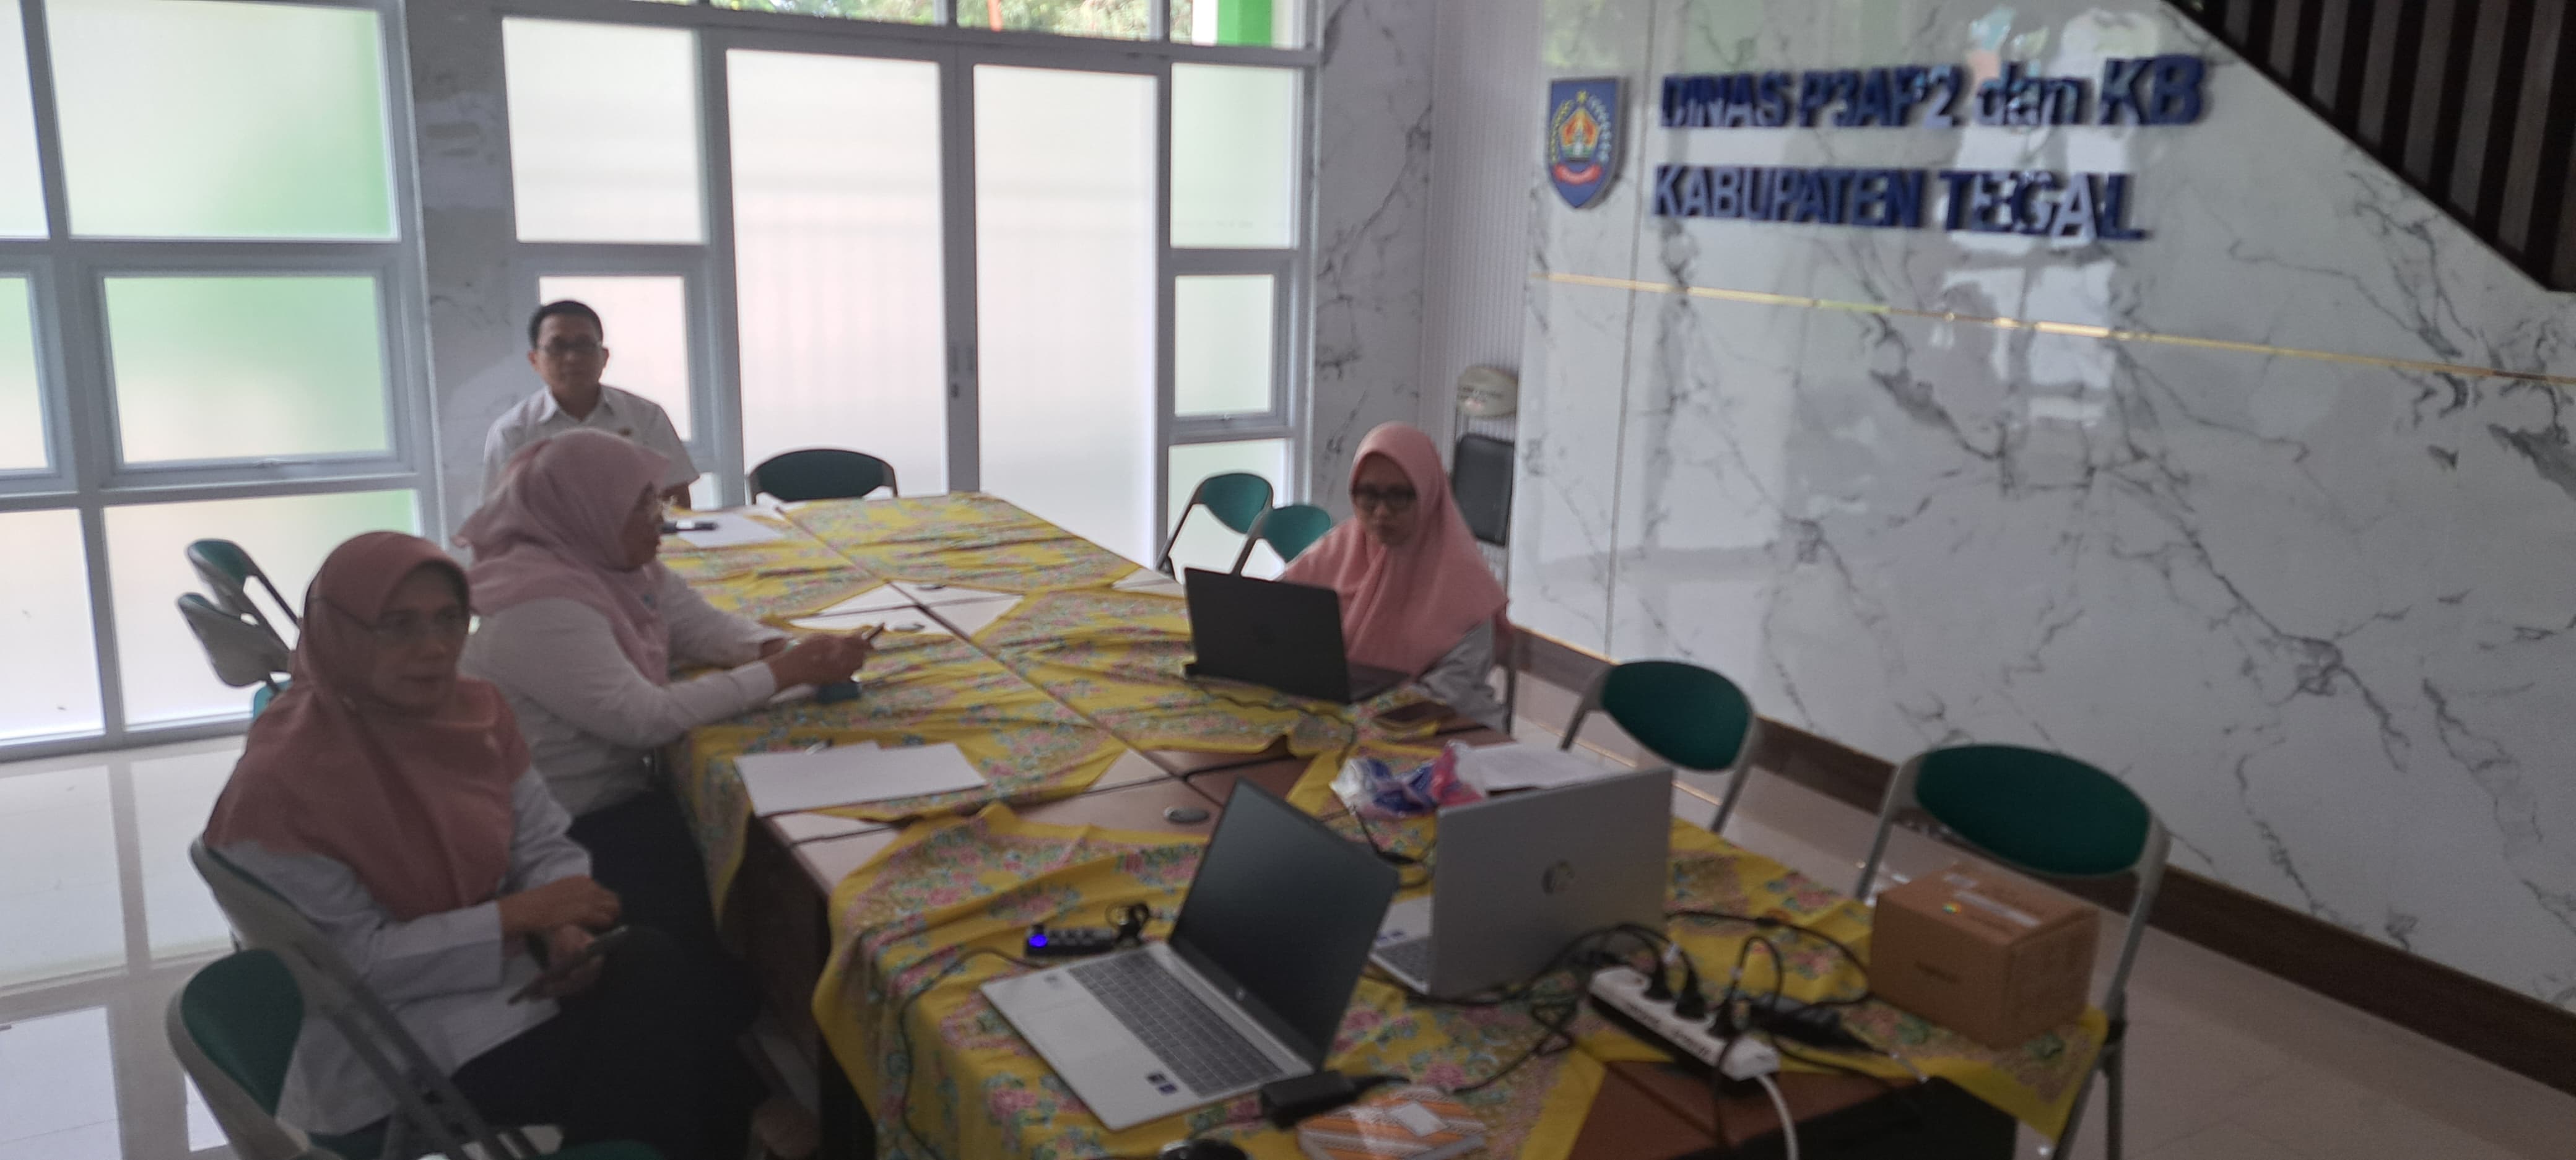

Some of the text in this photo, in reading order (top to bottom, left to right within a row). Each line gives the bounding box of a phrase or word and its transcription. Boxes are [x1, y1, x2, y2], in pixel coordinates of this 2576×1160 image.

[1661, 53, 2205, 128] DINAS P3AP2 dan KB
[1655, 165, 2147, 240] KABUPATEN TEGAL
